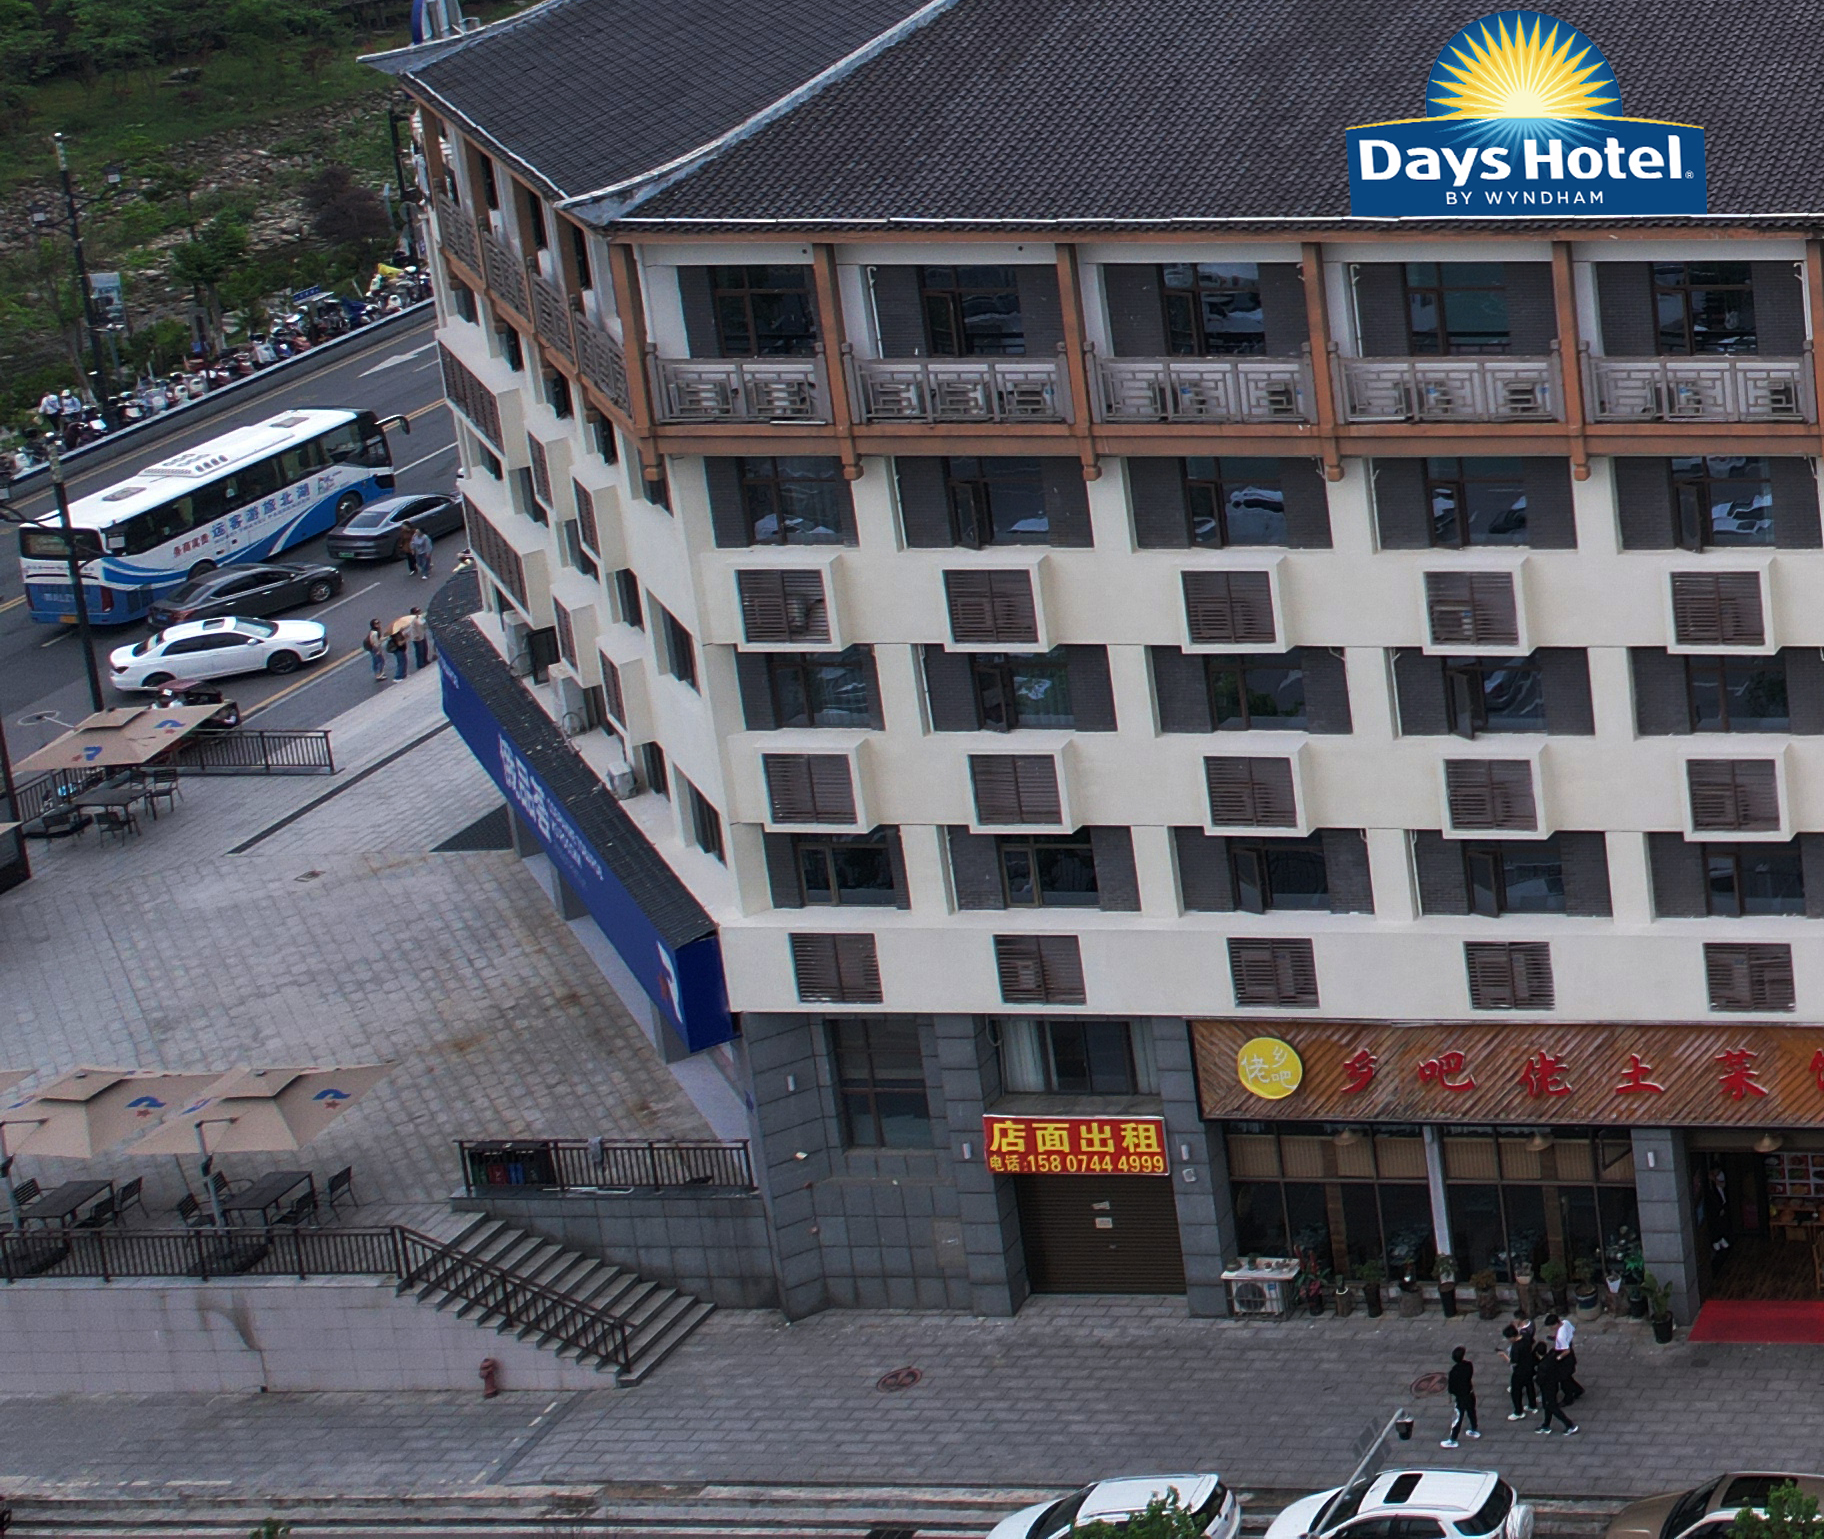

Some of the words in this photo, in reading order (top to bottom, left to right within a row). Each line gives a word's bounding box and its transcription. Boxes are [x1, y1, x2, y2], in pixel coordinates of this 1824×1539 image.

[1358, 139, 1510, 187] Days
[1523, 135, 1682, 180] Hotel
[1445, 191, 1473, 205] BY
[1485, 190, 1604, 205] WYNDHAM
[989, 1120, 1162, 1153] 店面出租
[1066, 1155, 1113, 1172] 0744
[1117, 1155, 1164, 1173] 4999
